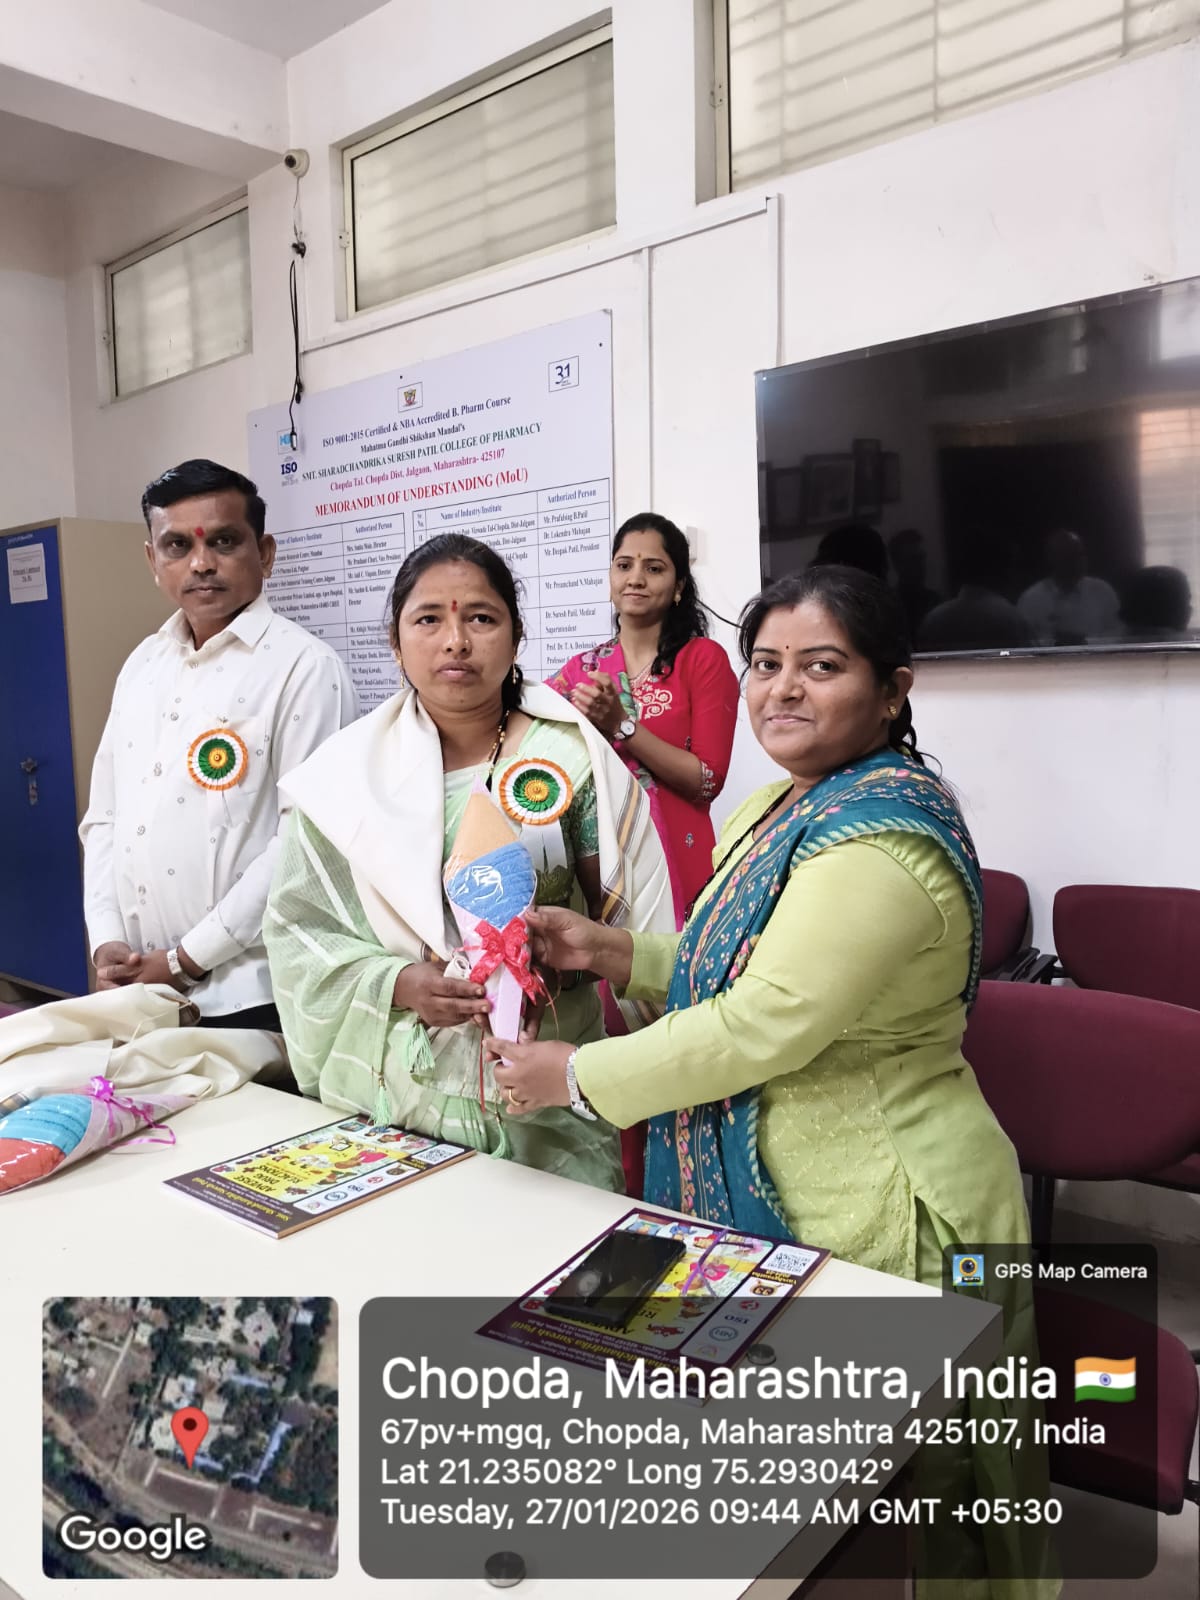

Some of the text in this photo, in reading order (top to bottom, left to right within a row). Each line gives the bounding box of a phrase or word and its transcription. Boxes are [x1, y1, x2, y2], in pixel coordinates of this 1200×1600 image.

[322, 396, 511, 448] ISO 9001:2015 Certified & NBA Accredited B. Pharm Course
[360, 423, 465, 453] Mahatma Gandhi Shikshan Mandal's
[302, 422, 542, 480] SMT. SHARADCHANDRIKA SURESH PATIL COLLEGE OF PHARMACY
[281, 462, 297, 475] ISO
[330, 479, 353, 492] Chopda
[366, 471, 389, 485] Chopda
[433, 456, 479, 471] Maharashtra-
[480, 448, 505, 462] 425107
[315, 468, 528, 517] MEMORANDUM OF UNDERSTANDING (MoU)
[547, 488, 597, 503] Authorized Person
[440, 511, 454, 520] Name
[460, 507, 481, 518] Industry
[481, 504, 502, 514] Institute
[253, 1173, 280, 1185] DRUG
[257, 1165, 300, 1184] REACTIONS
[233, 1175, 276, 1192] ADVERSE
[511, 1320, 537, 1334] Patil
[724, 1316, 749, 1324] ISO
[537, 1329, 574, 1344] Suresh
